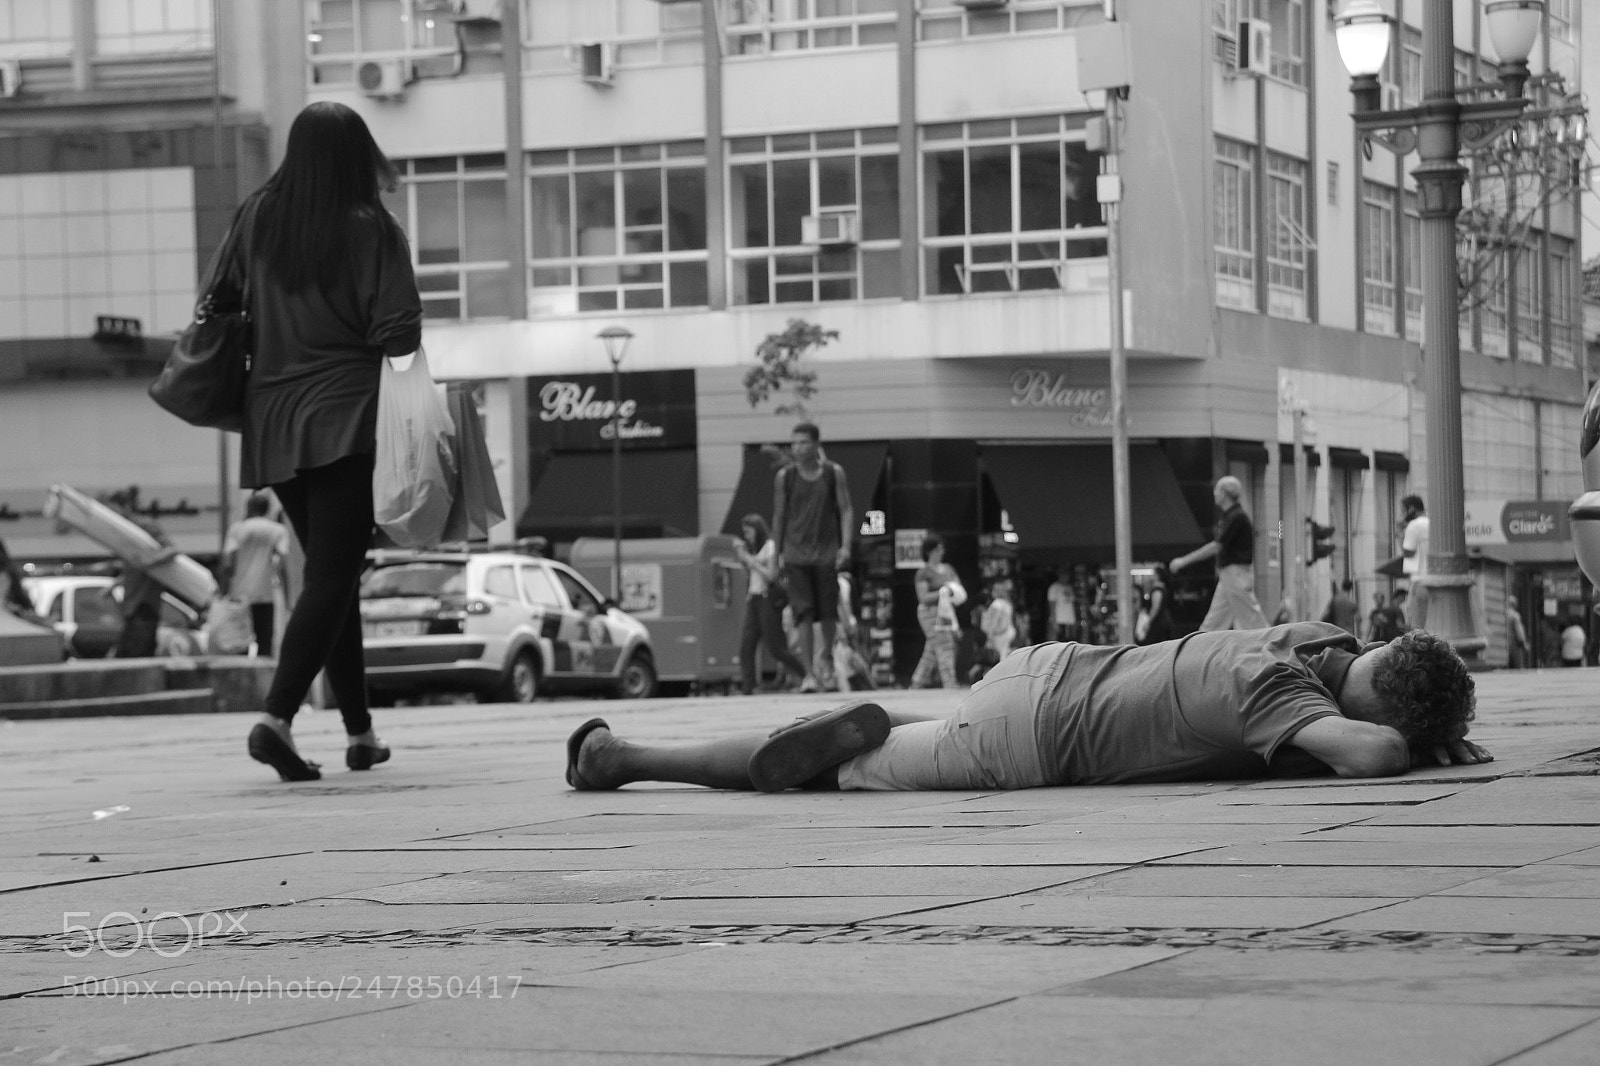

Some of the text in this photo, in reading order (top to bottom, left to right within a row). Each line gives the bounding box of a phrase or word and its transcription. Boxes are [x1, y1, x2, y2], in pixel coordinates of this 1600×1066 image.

[539, 381, 637, 421] Blanc
[1009, 368, 1106, 408] Blanc
[1509, 515, 1554, 535] Claro
